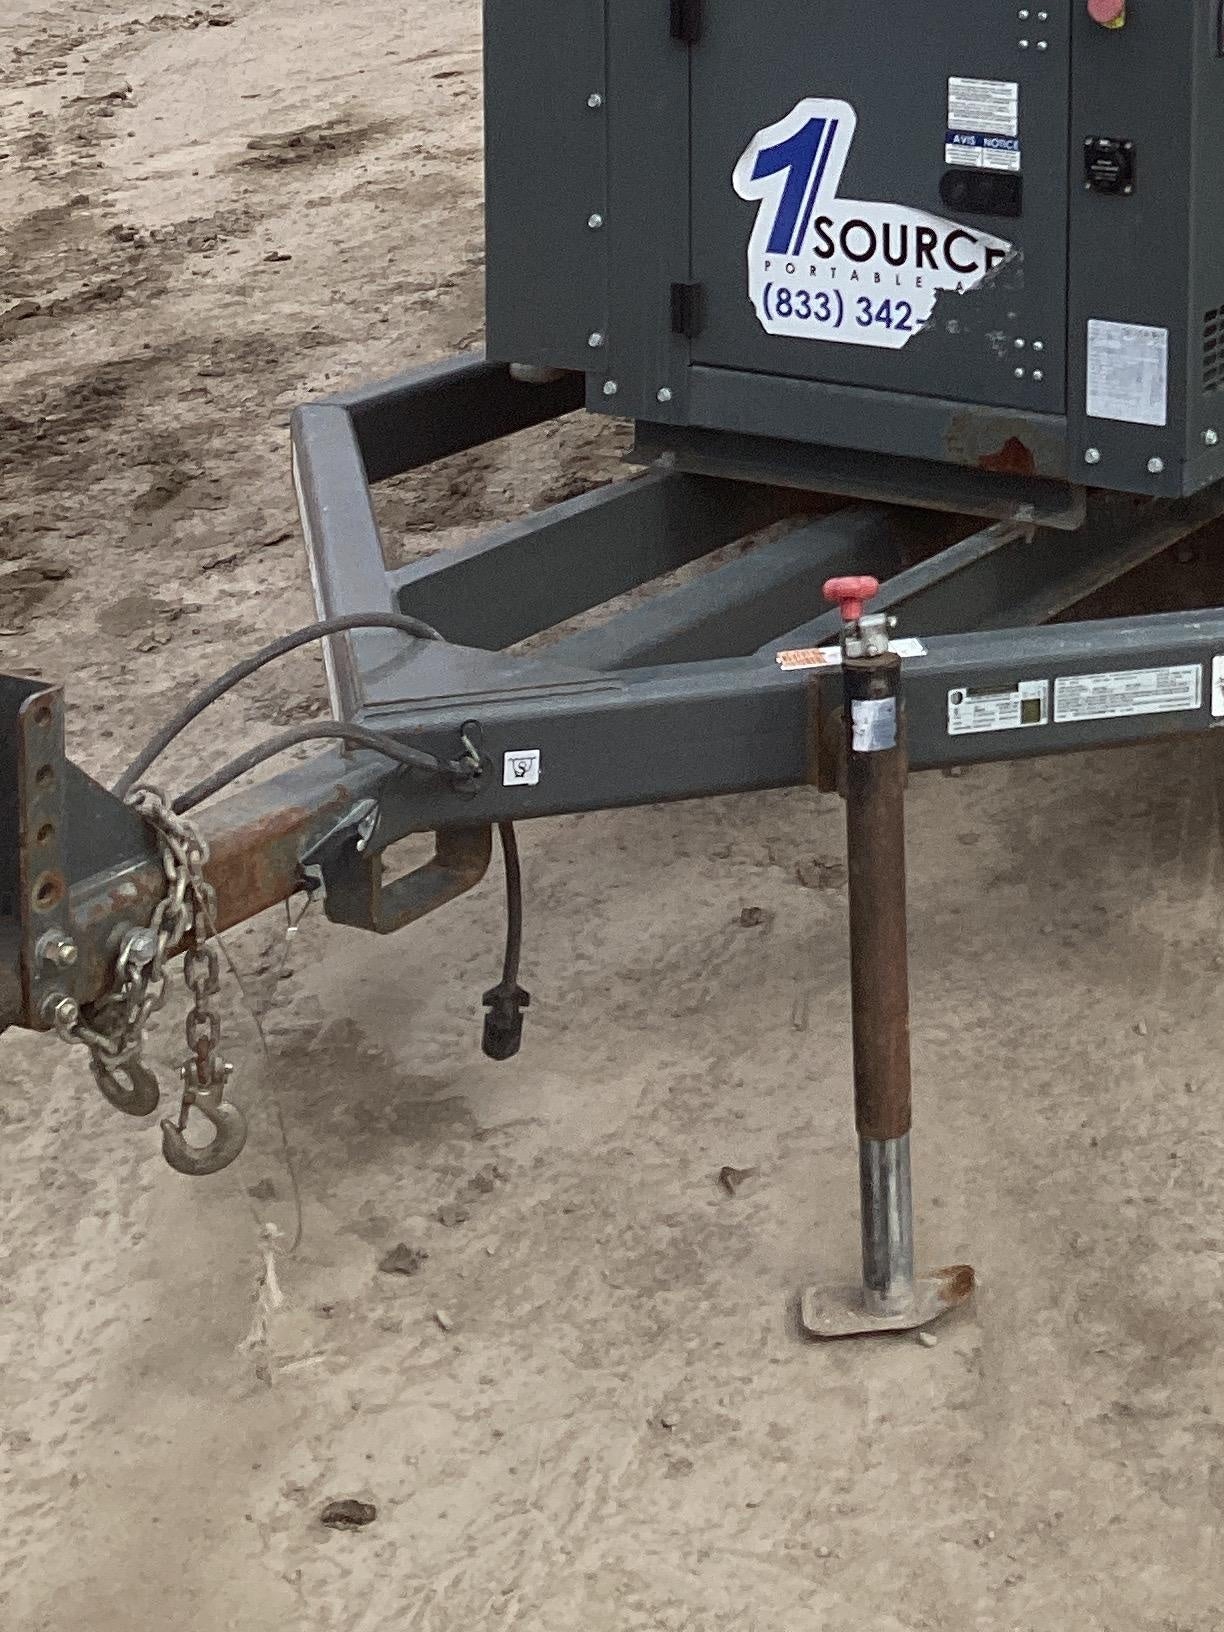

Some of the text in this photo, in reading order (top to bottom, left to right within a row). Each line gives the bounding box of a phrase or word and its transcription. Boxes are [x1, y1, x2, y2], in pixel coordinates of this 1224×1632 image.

[953, 134, 977, 147] AVIS
[751, 117, 839, 256] 1
[764, 260, 923, 288] PORTABLE
[763, 282, 844, 328] (833)
